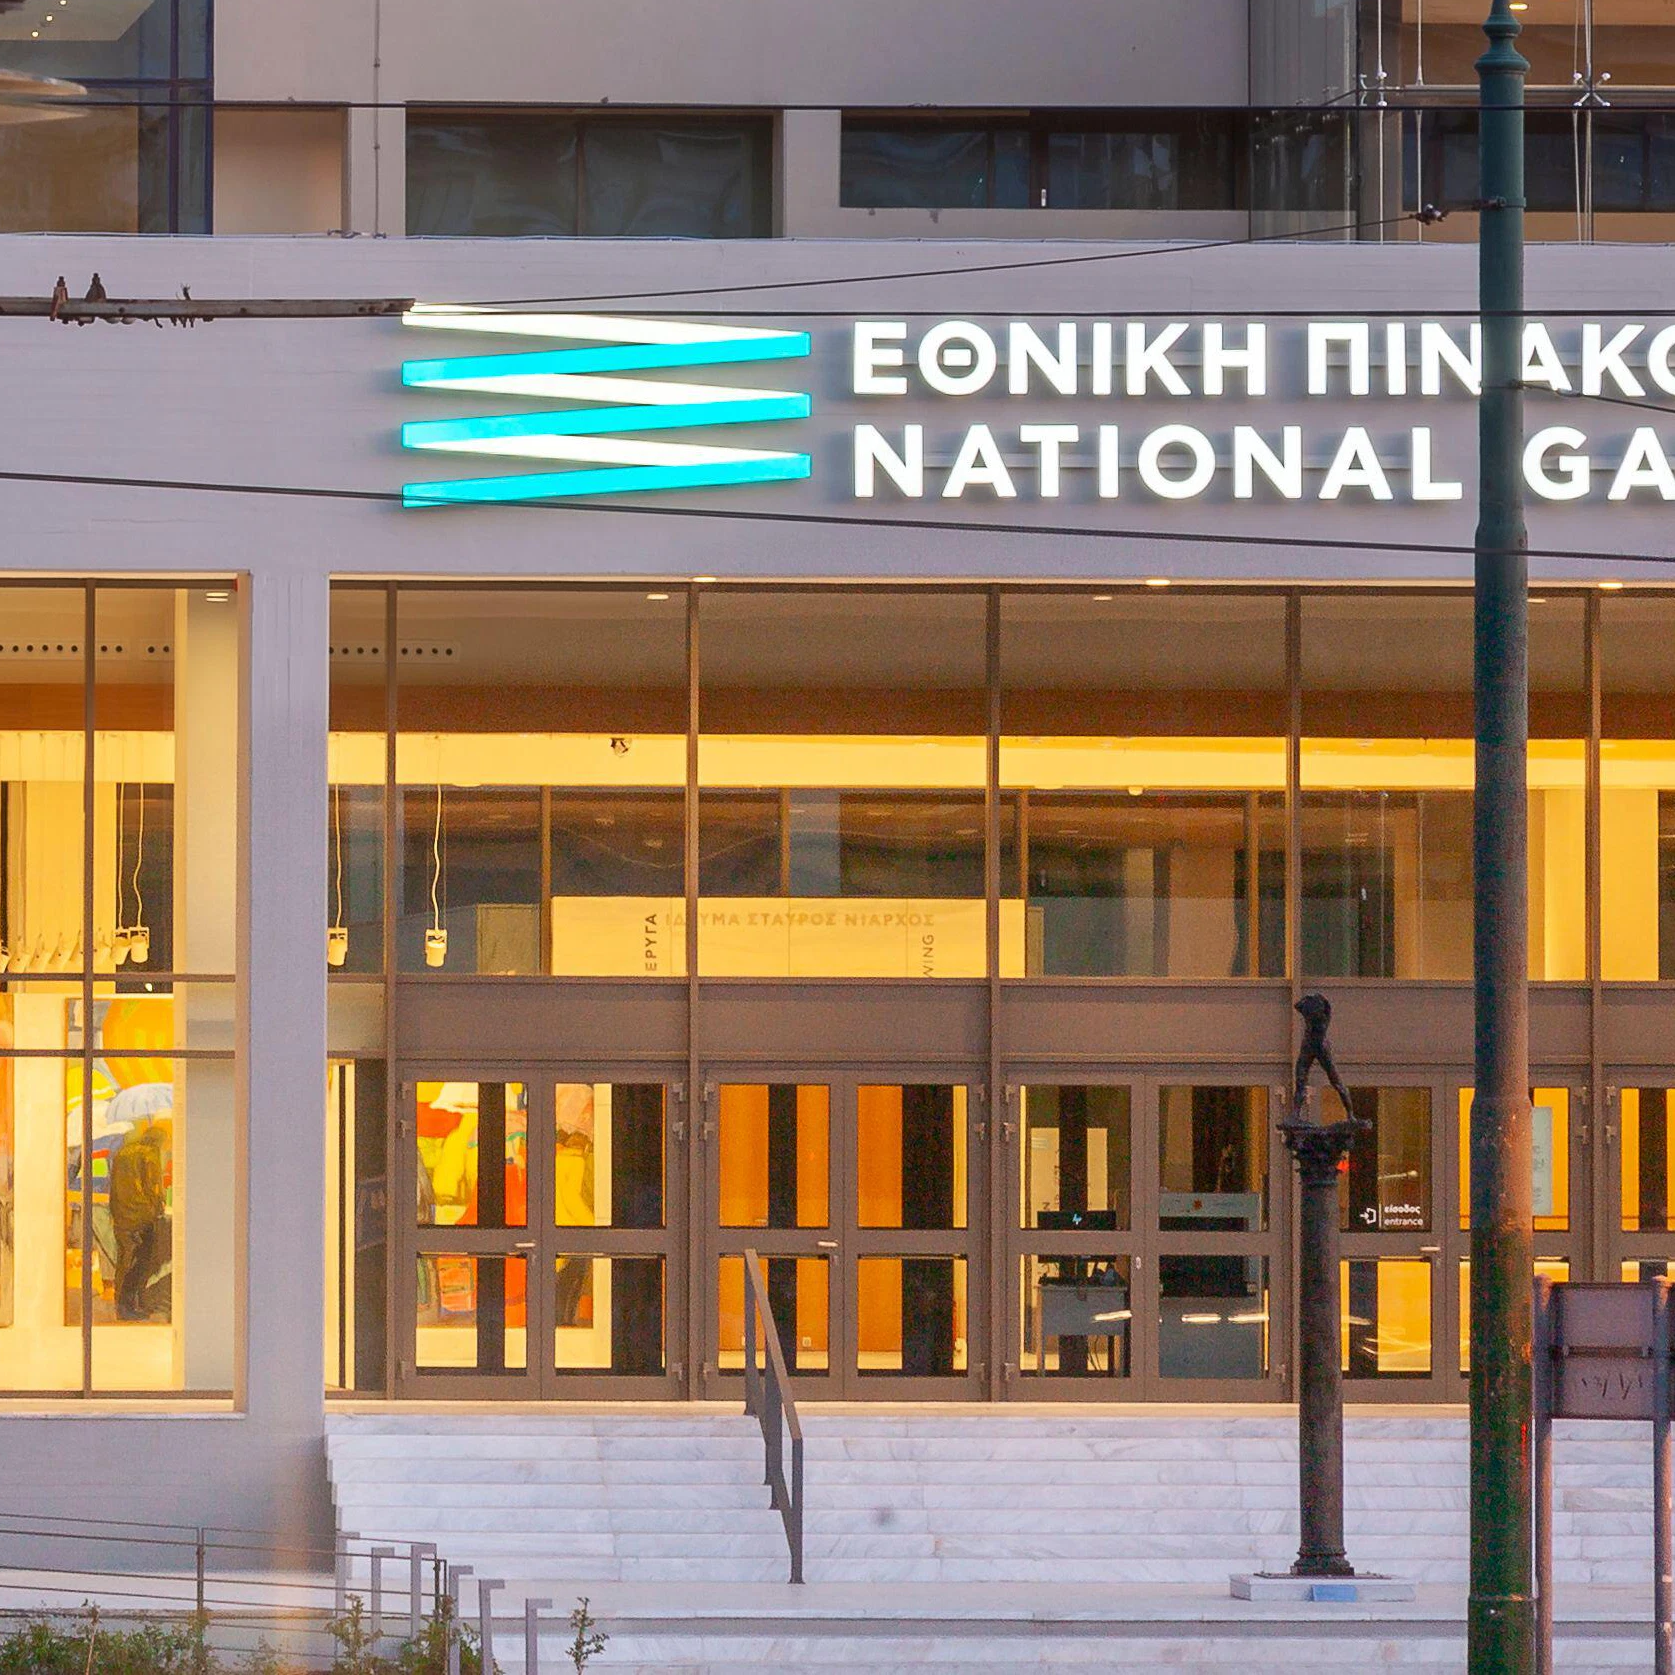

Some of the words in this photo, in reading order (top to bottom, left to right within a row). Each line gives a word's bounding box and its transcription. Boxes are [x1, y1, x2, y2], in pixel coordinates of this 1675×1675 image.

[853, 321, 1267, 396] ΕΘΝΙΚΗ
[854, 424, 1463, 500] NATIONAL
[1522, 426, 1675, 501] GA
[665, 913, 740, 926] ΙΔΥΜΑ
[747, 913, 837, 926] ΣΤΑΥΡΟΣ
[844, 913, 935, 927] ΝΙΑΡΧΟΣ
[1384, 1217, 1424, 1226] entrance
